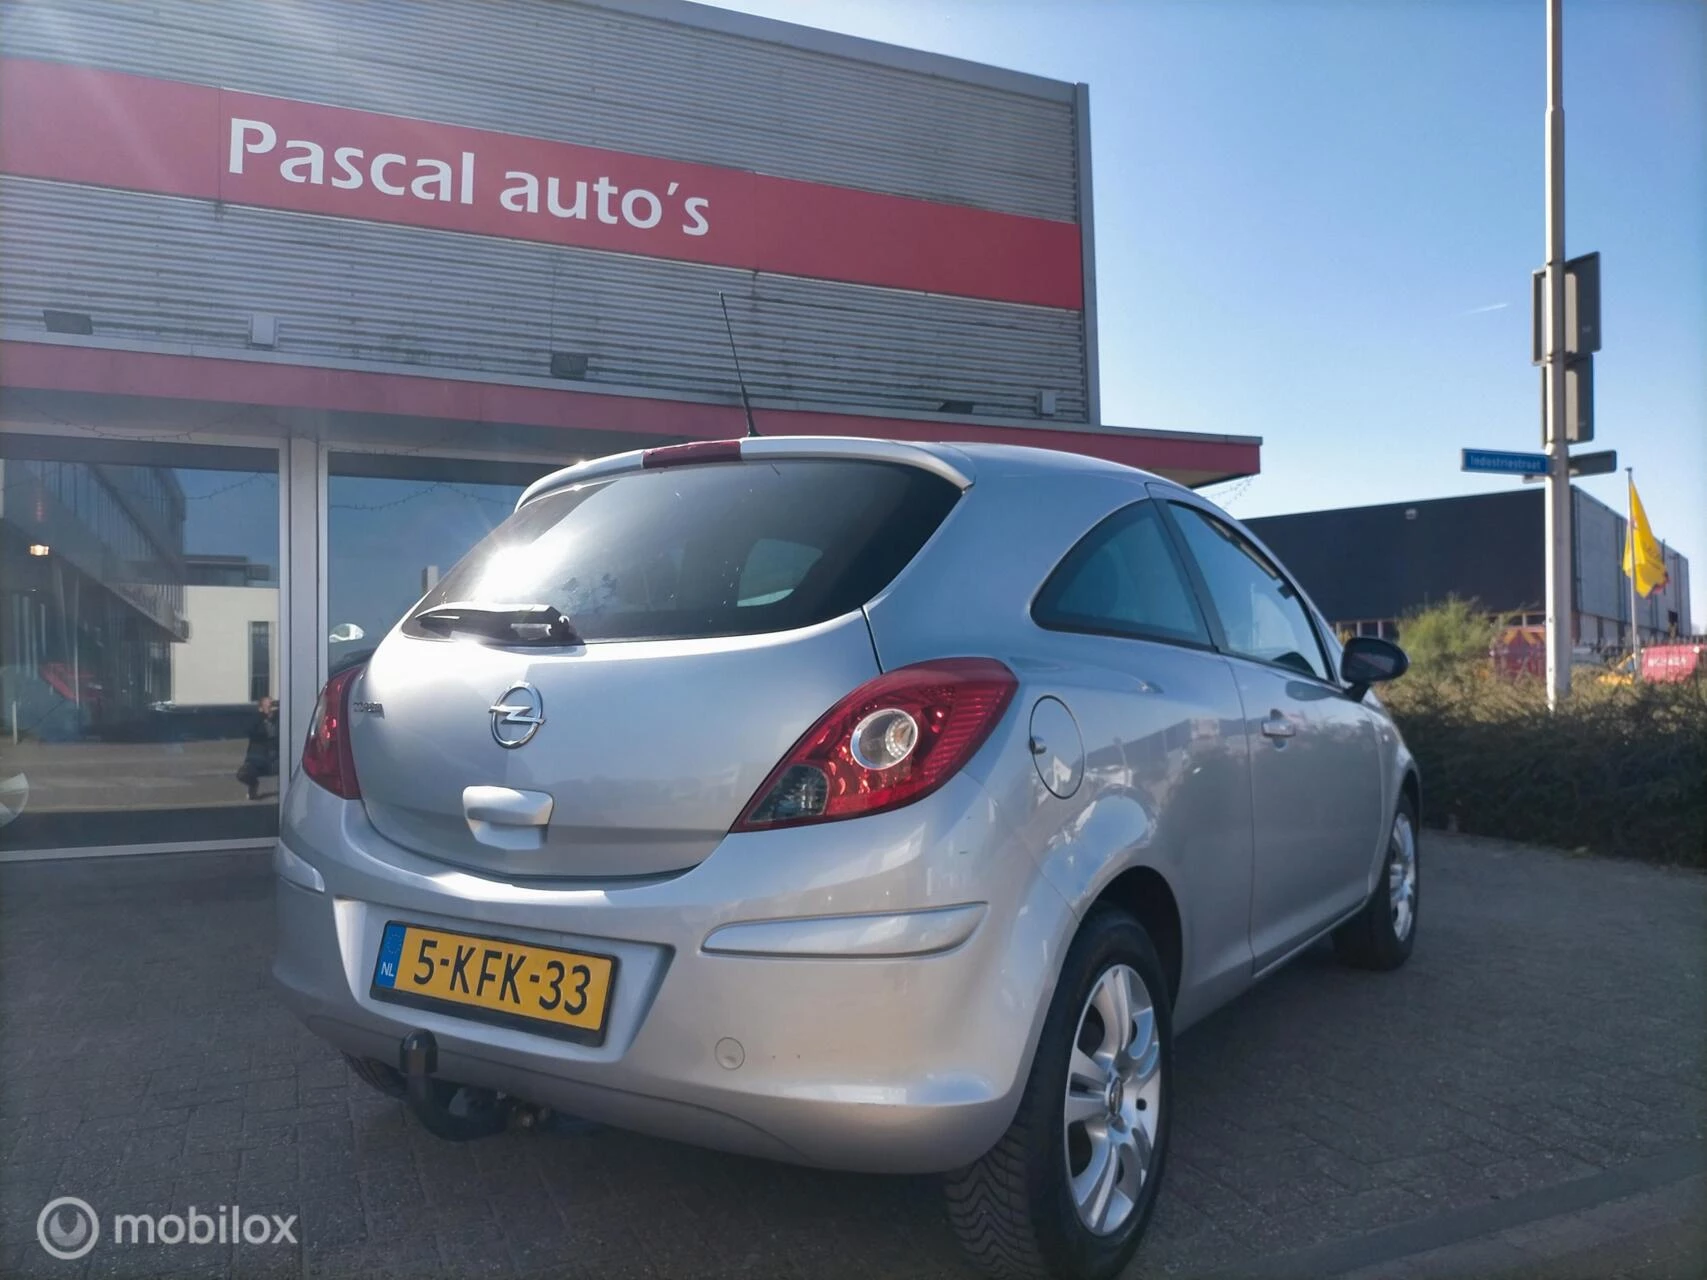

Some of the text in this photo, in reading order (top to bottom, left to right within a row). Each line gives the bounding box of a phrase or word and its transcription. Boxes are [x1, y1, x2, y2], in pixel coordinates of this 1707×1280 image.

[228, 117, 709, 236] Pascal auto's
[1470, 455, 1541, 470] Industriestraat
[381, 962, 394, 978] NL
[413, 939, 591, 1015] 5-KFK-33
